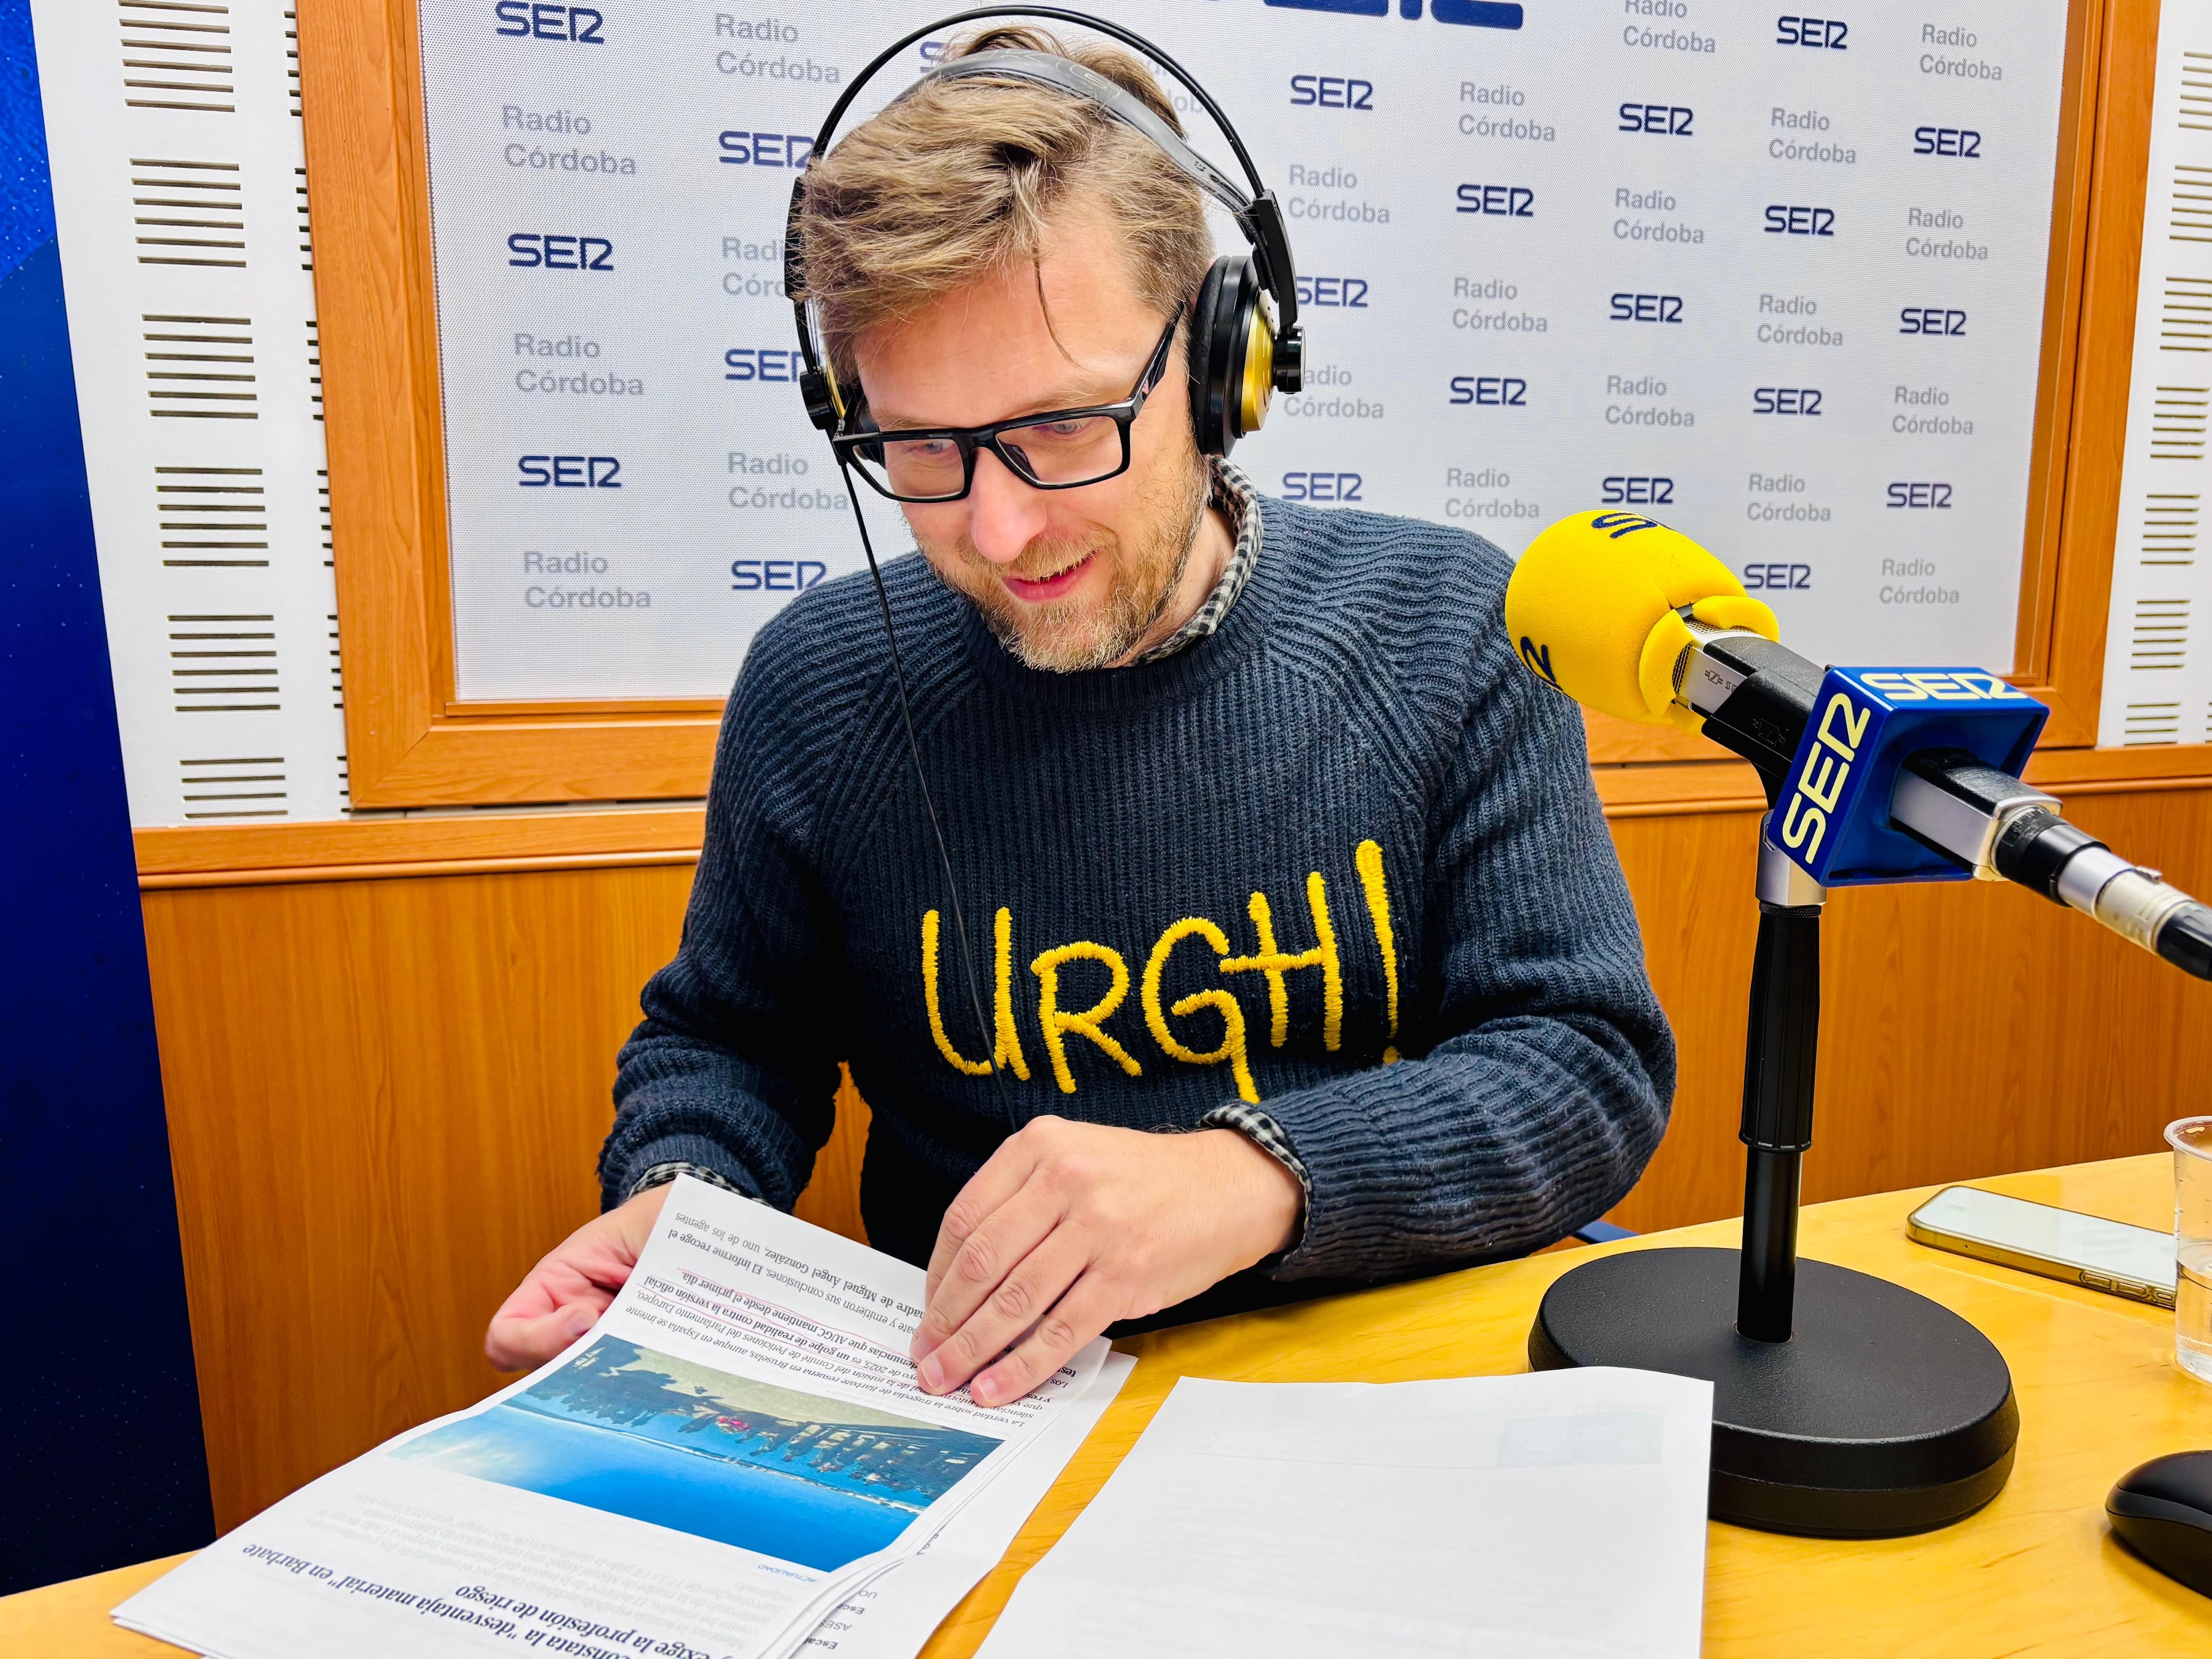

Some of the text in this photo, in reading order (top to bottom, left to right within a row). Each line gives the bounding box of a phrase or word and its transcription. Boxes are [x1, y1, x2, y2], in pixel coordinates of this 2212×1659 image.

[495, 0, 604, 44] SER
[714, 13, 799, 42] Radio
[1777, 15, 1848, 50] SER
[1622, 25, 1716, 54] Córdoba
[1921, 23, 1978, 48] Radio
[716, 50, 840, 84] Córdoba
[1920, 55, 2003, 82] Córdoba
[1290, 74, 1373, 111] SER
[1459, 81, 1525, 107] Radio
[502, 105, 592, 135] Radio
[1458, 114, 1556, 142] Córdoba
[1618, 103, 1694, 136] SER
[1770, 107, 1830, 132] Radio
[1769, 139, 1856, 165] Córdoba
[1914, 127, 1981, 158] SER
[505, 143, 637, 176] Córdoba
[1289, 164, 1357, 189] Radio
[1289, 197, 1390, 224] Córdoba
[1457, 184, 1534, 217] SER
[1615, 188, 1676, 212] Radio
[1764, 205, 1835, 236] SER
[1908, 208, 1964, 230] Radio
[1613, 218, 1705, 245] Córdoba
[508, 234, 614, 271] SER
[722, 236, 784, 261] Radi
[1905, 238, 1989, 261] Córdoba
[1453, 277, 1517, 301] Radio
[1610, 292, 1683, 323] SER
[1759, 294, 1817, 316] Radio
[1452, 309, 1548, 333] Córdoba
[1900, 307, 1966, 336] SER
[513, 333, 600, 358] Radio
[1757, 324, 1843, 347] Córdoba
[515, 369, 643, 396] Córdoba
[1305, 364, 1352, 386] adio
[1605, 375, 1667, 397] Radio
[1450, 377, 1526, 406] SER
[1753, 387, 1822, 416] SER
[1894, 386, 1949, 406] Radio
[1284, 396, 1384, 419] Córdoba
[1605, 406, 1695, 427] Córdoba
[1892, 415, 1974, 435] Córdoba
[518, 455, 621, 488] SER
[727, 452, 808, 476] Radio
[1282, 472, 1362, 501] SER
[1447, 468, 1509, 489] Radio
[1749, 473, 1805, 493] Radio
[1601, 476, 1674, 505] SER
[1886, 482, 1952, 508] SER
[1445, 498, 1540, 519] Córdoba
[1747, 503, 1831, 522] Córdoba
[523, 552, 608, 574] Radio
[1882, 557, 1936, 577] Radio
[1744, 564, 1810, 590] SER
[525, 586, 651, 609] Córdoba
[1879, 587, 1959, 605] Córdoba
[1860, 673, 2028, 700] SER
[1782, 693, 1871, 864] SER
[922, 839, 1399, 1104] URGH!
[675, 1213, 710, 1232] agentes
[712, 1228, 726, 1241] los
[728, 1234, 740, 1246] de
[742, 1240, 760, 1253] uno
[764, 1247, 809, 1274] González,
[644, 1276, 674, 1293] oficial
[682, 1271, 698, 1286] día.
[698, 1279, 734, 1299] primer
[811, 1268, 841, 1288] Ángel
[637, 1290, 676, 1313] Europeo,
[675, 1289, 709, 1309] versión
[732, 1294, 743, 1303] el
[842, 1281, 878, 1302] Miguel
[880, 1296, 893, 1308] de
[626, 1306, 657, 1324] intente
[668, 1229, 1068, 1388] Los y emitieron sus conclusiones. El informe recoge el
[711, 1304, 722, 1315] la
[722, 1308, 753, 1325] contra
[743, 1298, 772, 1316] desde
[668, 1322, 700, 1340] España
[675, 1308, 727, 1333] Parlamento
[772, 1310, 819, 1333] mantiene
[700, 1334, 713, 1343] en
[726, 1328, 742, 1338] del
[752, 1321, 795, 1344] realidad
[792, 1337, 808, 1348] de
[817, 1328, 849, 1344] AUGC
[713, 1339, 748, 1355] aunque
[742, 1334, 788, 1355] Peticiones
[788, 1350, 801, 1359] de
[808, 1342, 838, 1355] golpe
[836, 1352, 850, 1360] un
[848, 1340, 868, 1351] que
[749, 1350, 789, 1369] Bruselas,
[800, 1355, 834, 1370] Comité
[834, 1366, 851, 1374] del
[858, 1360, 888, 1374] 2025,
[803, 1368, 840, 1382] resuena
[841, 1379, 879, 1391] Barbate
[852, 1371, 885, 1382] misión
[892, 1391, 932, 1405] tragedia
[944, 1405, 973, 1414] sobre
[972, 1412, 1009, 1423] verdad
[242, 1544, 312, 1574] Barbate
[308, 1565, 333, 1579] en
[327, 1576, 418, 1605] material"
[455, 1586, 515, 1610] riesgo
[416, 1598, 517, 1639] "desventaja
[512, 1602, 539, 1619] de
[524, 1629, 547, 1647] la
[539, 1609, 637, 1644] profesión
[632, 1636, 655, 1653] la
